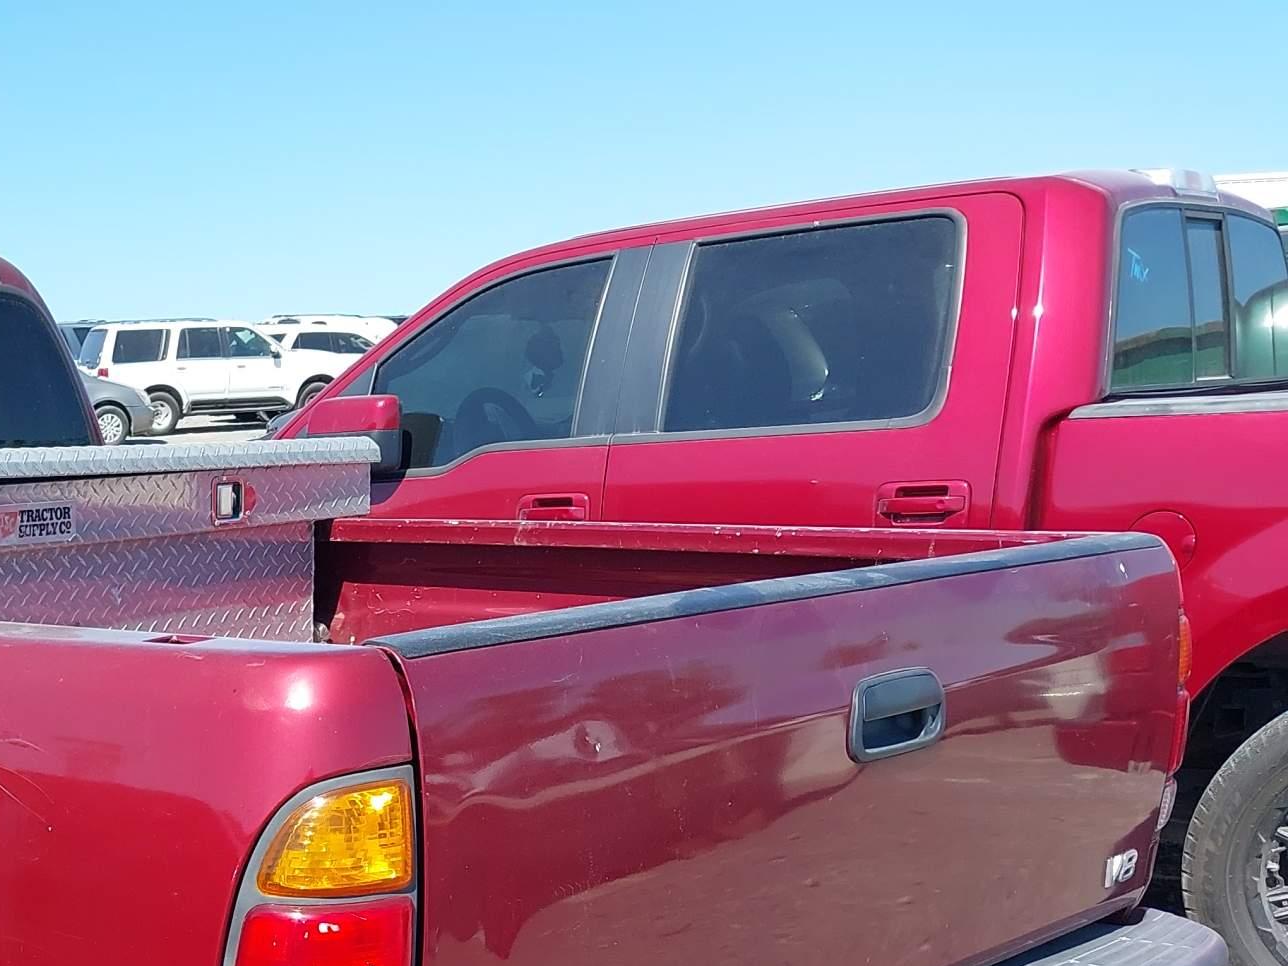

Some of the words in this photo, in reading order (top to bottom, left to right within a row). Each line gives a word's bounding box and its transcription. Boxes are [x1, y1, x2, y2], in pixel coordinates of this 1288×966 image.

[18, 506, 71, 523] TRACTOR
[18, 522, 59, 538] SUPPLY
[1104, 848, 1138, 889] V8
